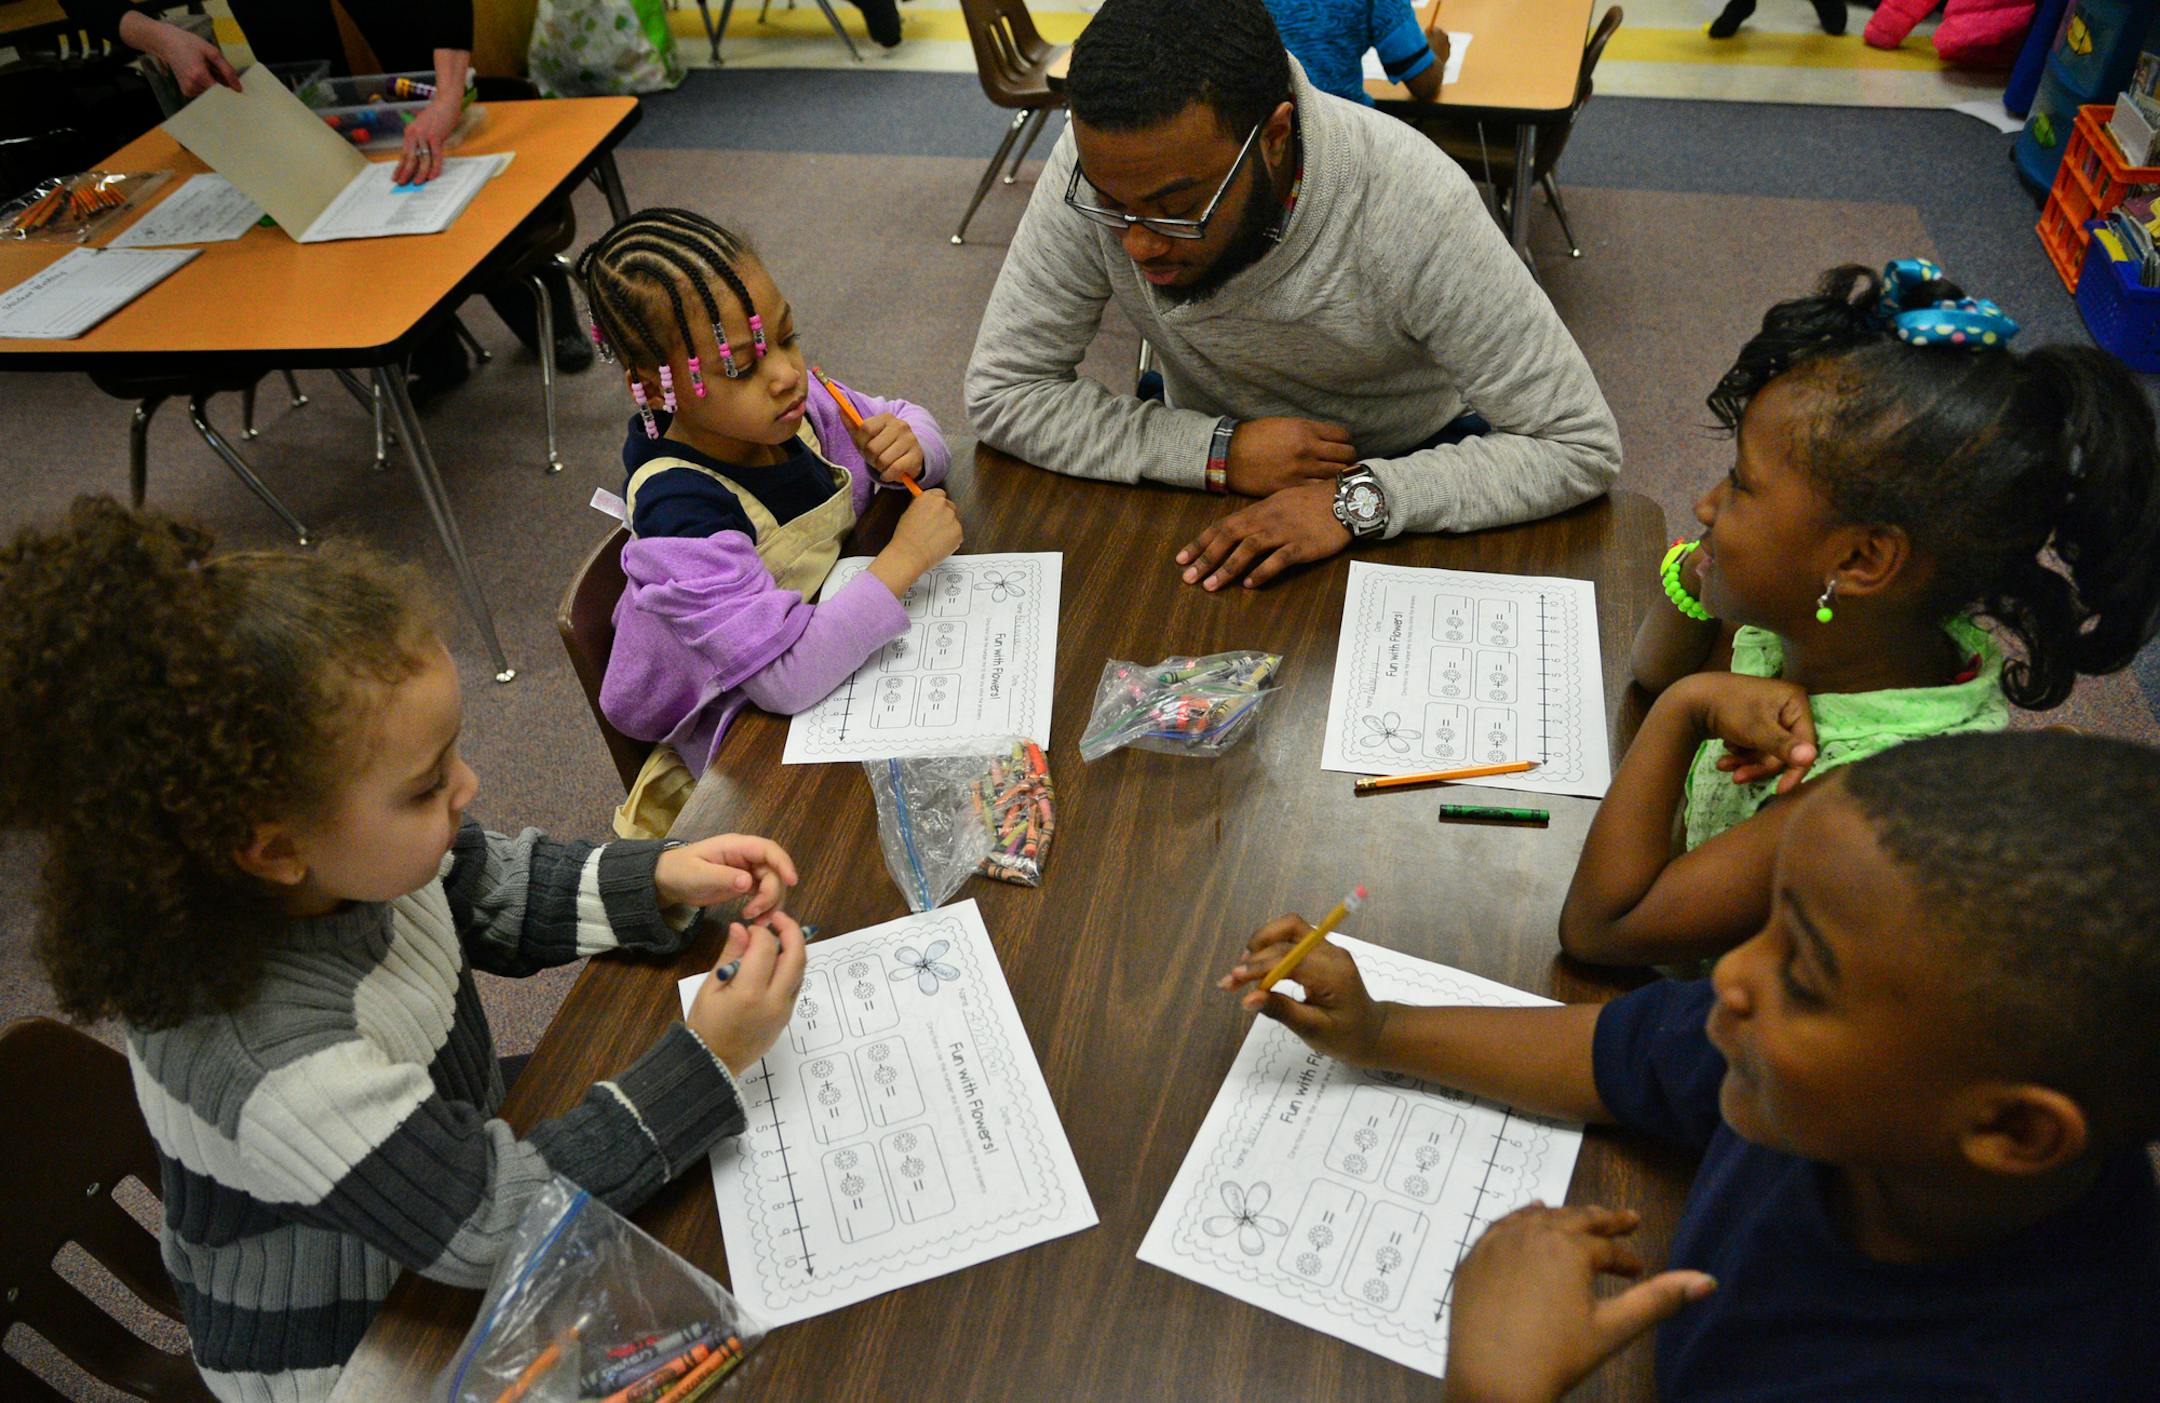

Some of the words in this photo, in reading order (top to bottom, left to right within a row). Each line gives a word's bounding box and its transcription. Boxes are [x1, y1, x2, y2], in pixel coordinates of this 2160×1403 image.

[1389, 610, 1404, 642] Flowers!
[995, 633, 1006, 647] Fun
[993, 649, 1004, 666] with
[1388, 643, 1400, 661] with
[1386, 662, 1398, 678] Fun
[990, 667, 1004, 700] Flowers!
[958, 988, 969, 1008] Name
[949, 1041, 964, 1067] Fun
[745, 1077, 758, 1085] 3
[958, 1067, 979, 1098] with
[751, 1100, 762, 1109] 4
[1280, 1099, 1304, 1125] Fun
[1296, 1067, 1317, 1097] with
[999, 1105, 1011, 1127] Date
[756, 1125, 769, 1134] 5
[968, 1098, 999, 1156] Flowers!
[761, 1150, 774, 1159] 6
[1491, 1191, 1505, 1199] 4
[1500, 1164, 1514, 1174] 5
[1510, 1139, 1522, 1148] 6
[767, 1175, 780, 1183] 7
[772, 1202, 785, 1212] 8
[778, 1227, 791, 1238] 9
[784, 1255, 798, 1269] 10
